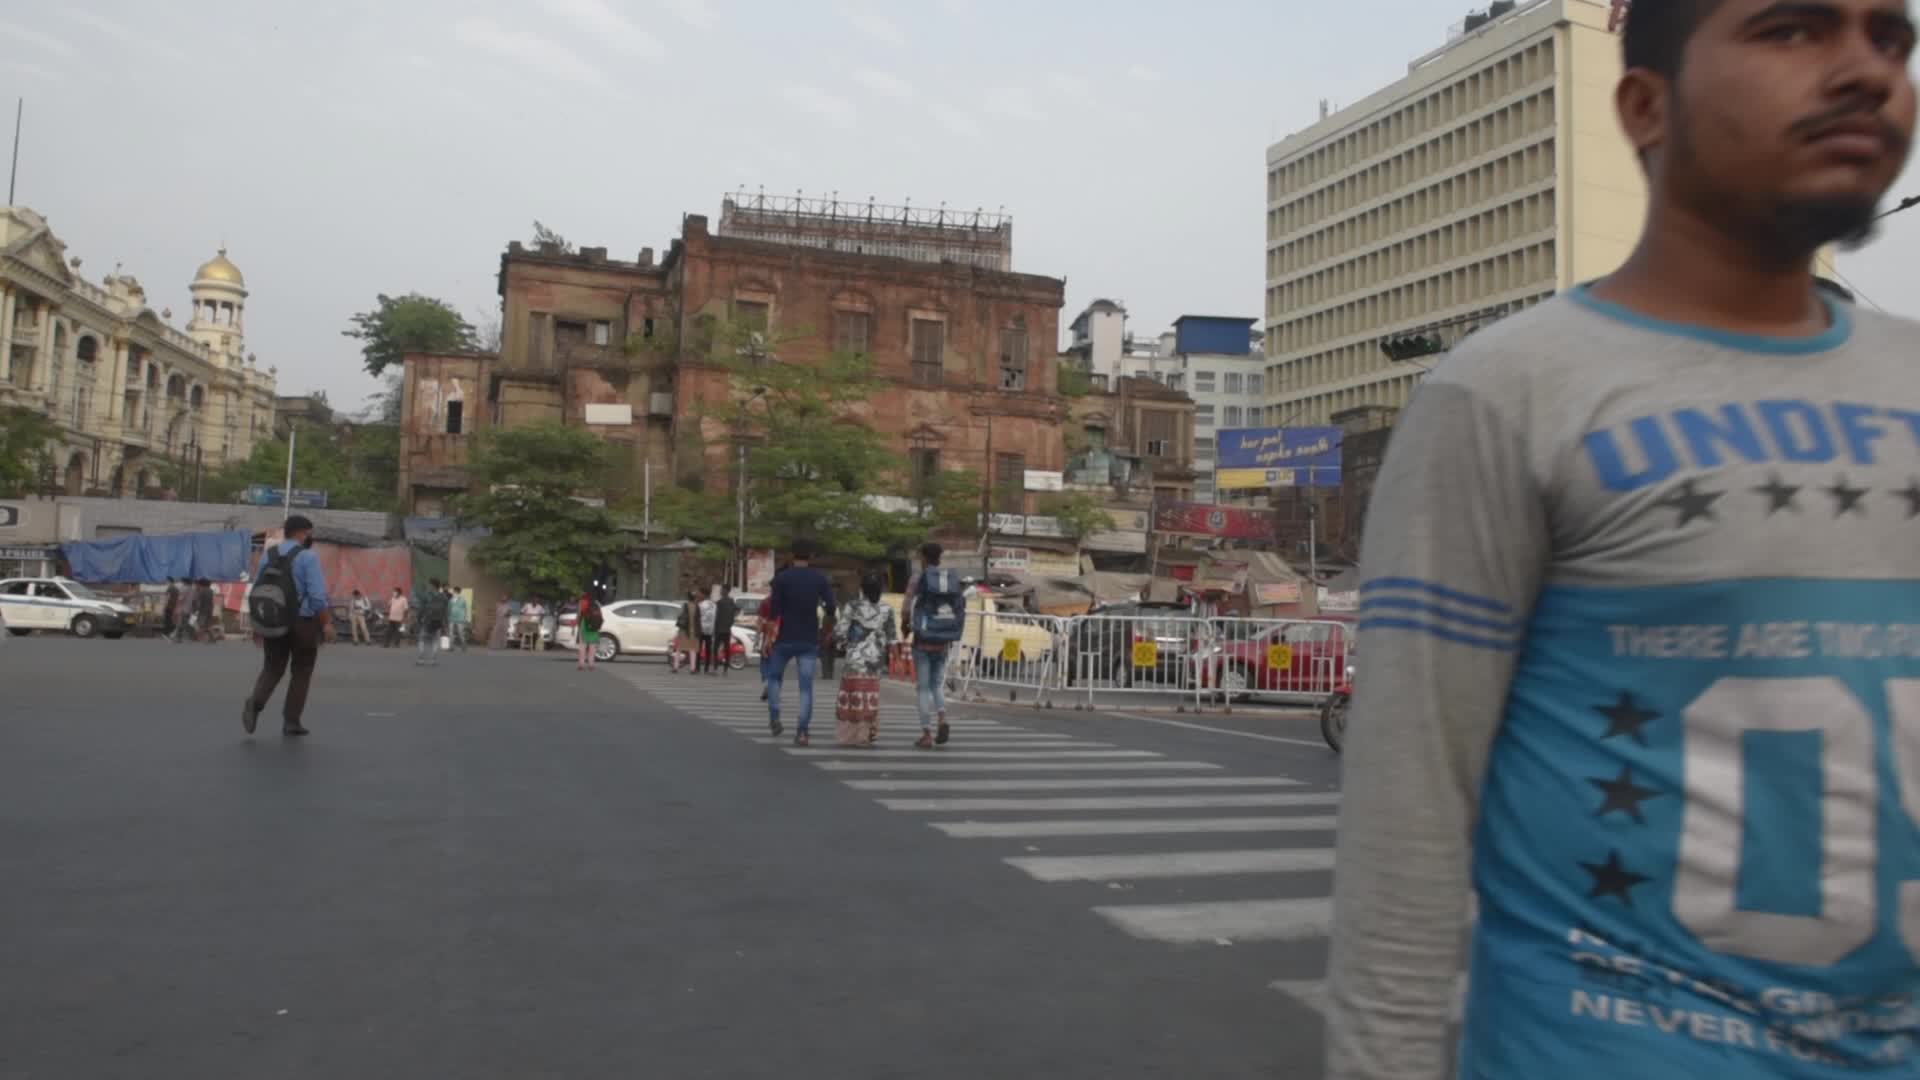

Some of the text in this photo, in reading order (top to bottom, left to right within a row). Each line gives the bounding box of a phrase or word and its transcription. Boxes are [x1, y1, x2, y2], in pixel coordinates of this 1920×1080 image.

[1608, 624, 1729, 658] THERE
[1733, 621, 1811, 658] ARE
[1571, 989, 1758, 1048] NEVER
